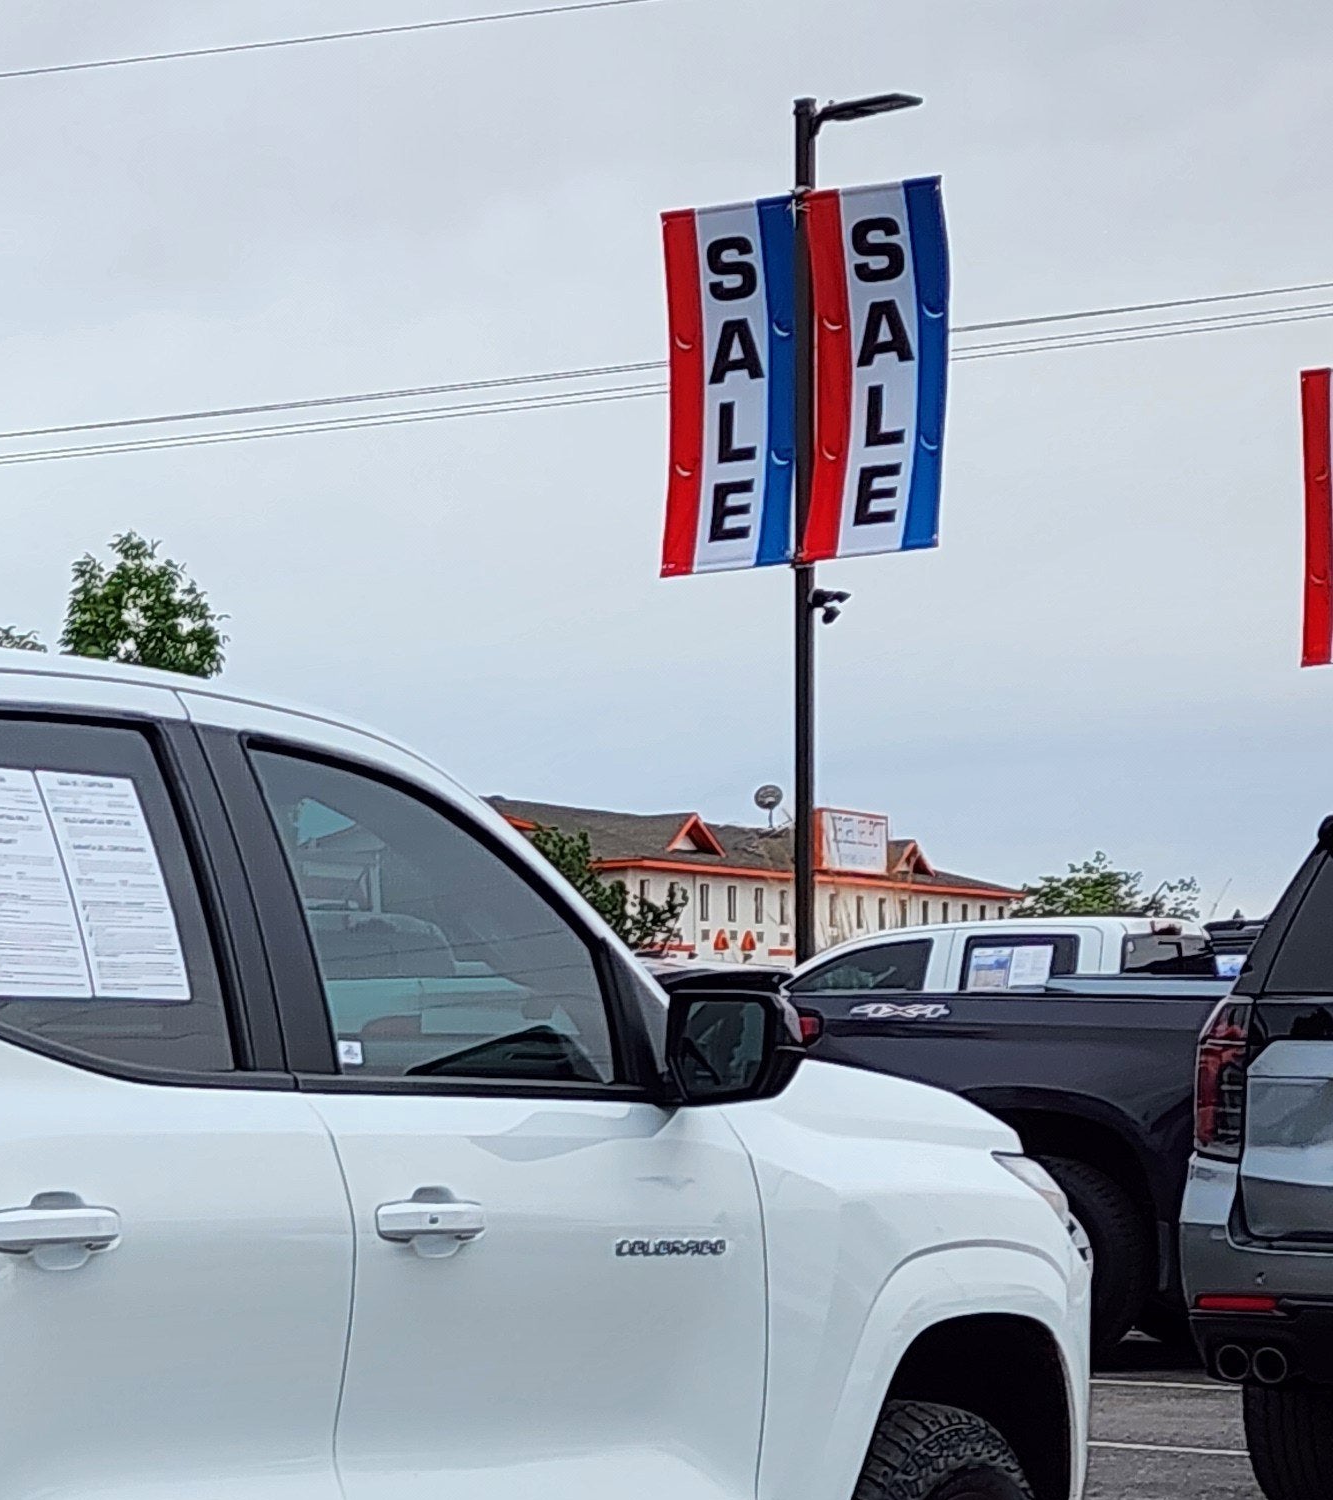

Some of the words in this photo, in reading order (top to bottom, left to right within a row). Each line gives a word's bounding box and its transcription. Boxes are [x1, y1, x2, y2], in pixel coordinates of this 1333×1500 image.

[706, 236, 765, 544] SALE
[850, 216, 915, 527] SALE
[615, 1239, 727, 1257] COLORADO
